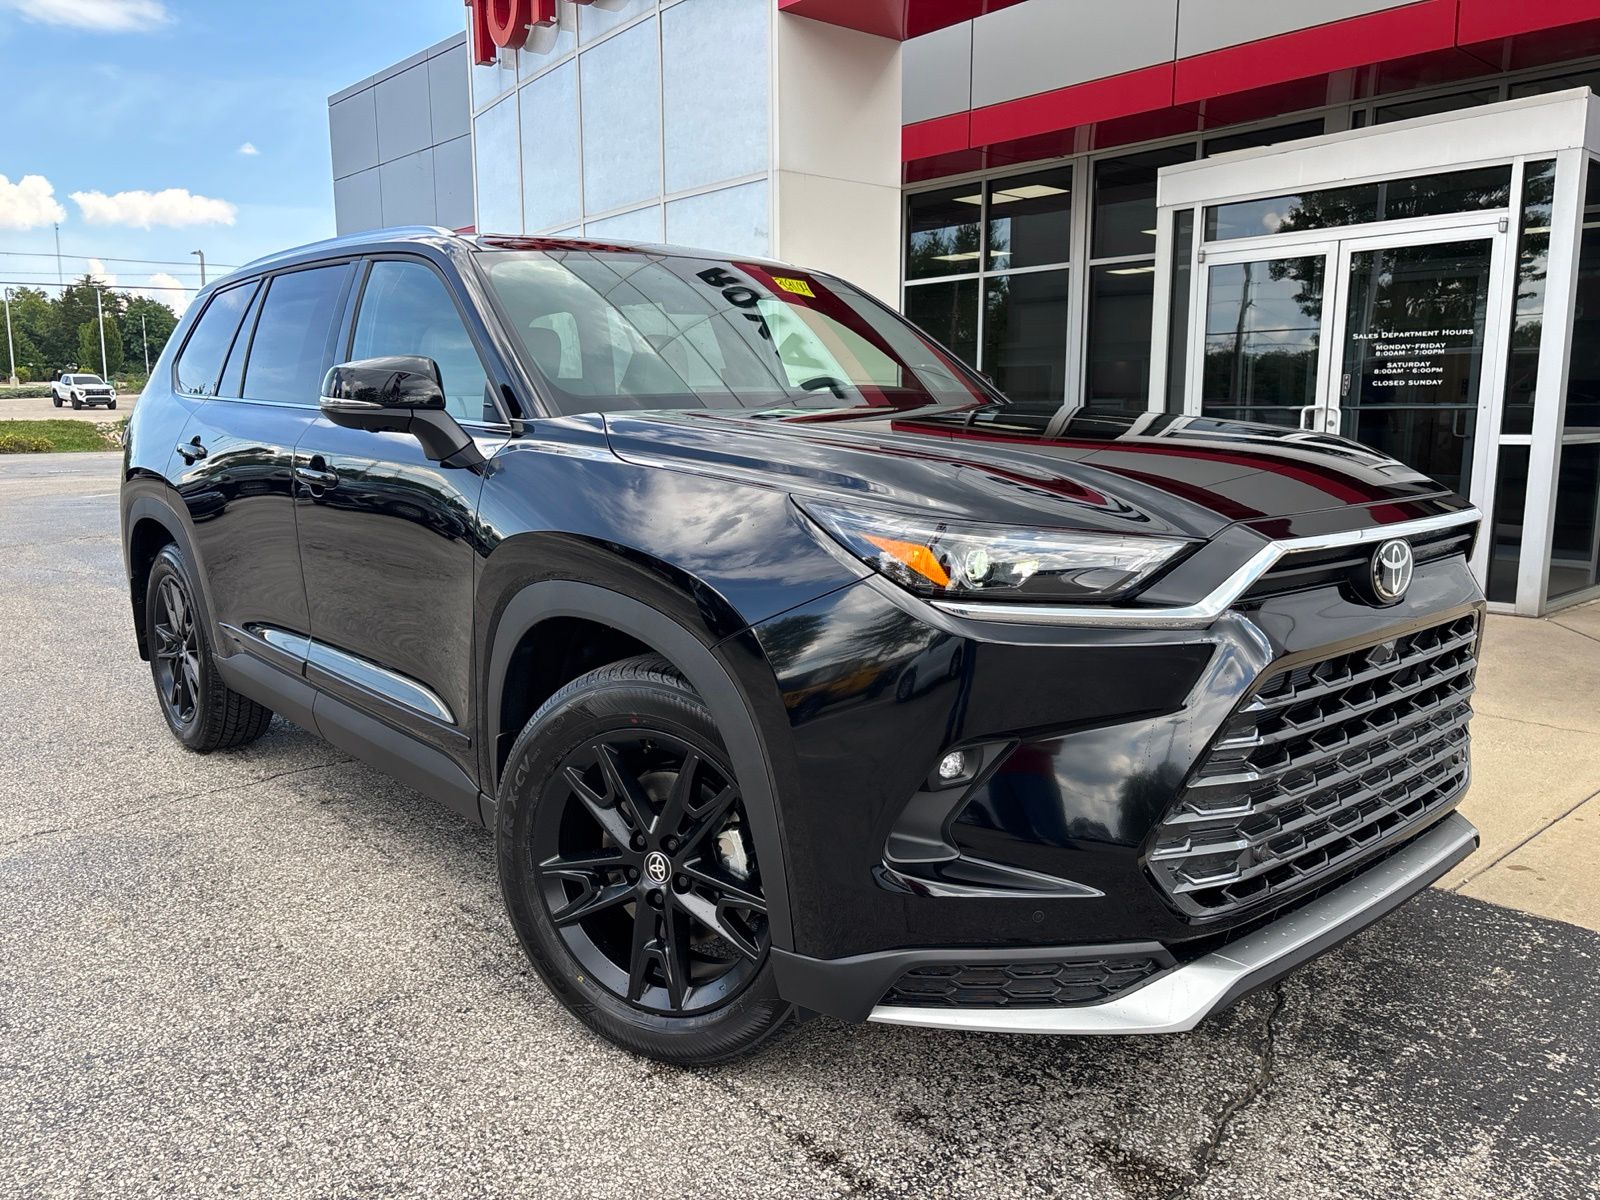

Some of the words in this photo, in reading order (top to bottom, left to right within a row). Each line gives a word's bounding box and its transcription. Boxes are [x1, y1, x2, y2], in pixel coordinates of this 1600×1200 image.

[1381, 330, 1440, 339] DEPARTMENT
[1441, 328, 1474, 336] HOURS
[507, 753, 531, 812] X-CV
